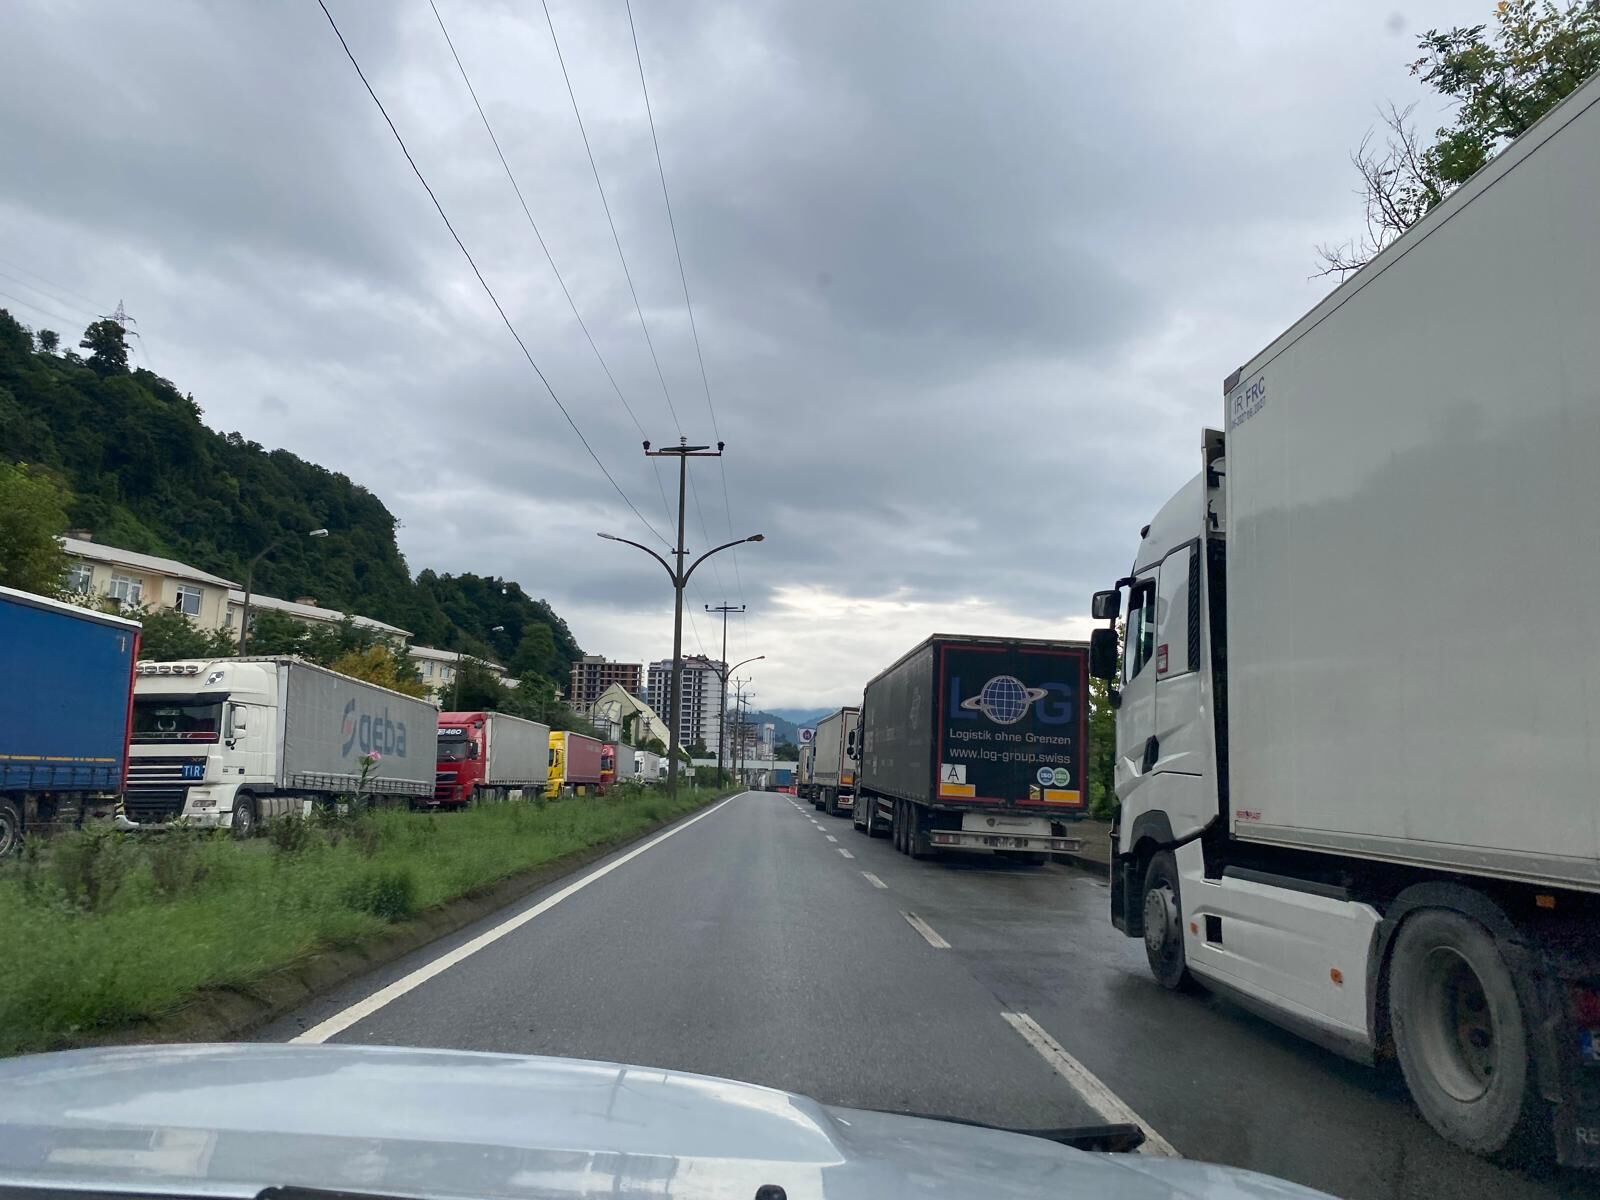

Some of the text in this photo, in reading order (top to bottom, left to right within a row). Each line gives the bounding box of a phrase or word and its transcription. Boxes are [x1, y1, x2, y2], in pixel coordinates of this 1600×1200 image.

[1245, 375, 1265, 408] FRC
[949, 728, 1071, 745] Logistik ohne Grenzen
[949, 747, 1071, 764] www.log-group.swiss
[183, 765, 201, 777] TIR
[947, 766, 960, 781] A
